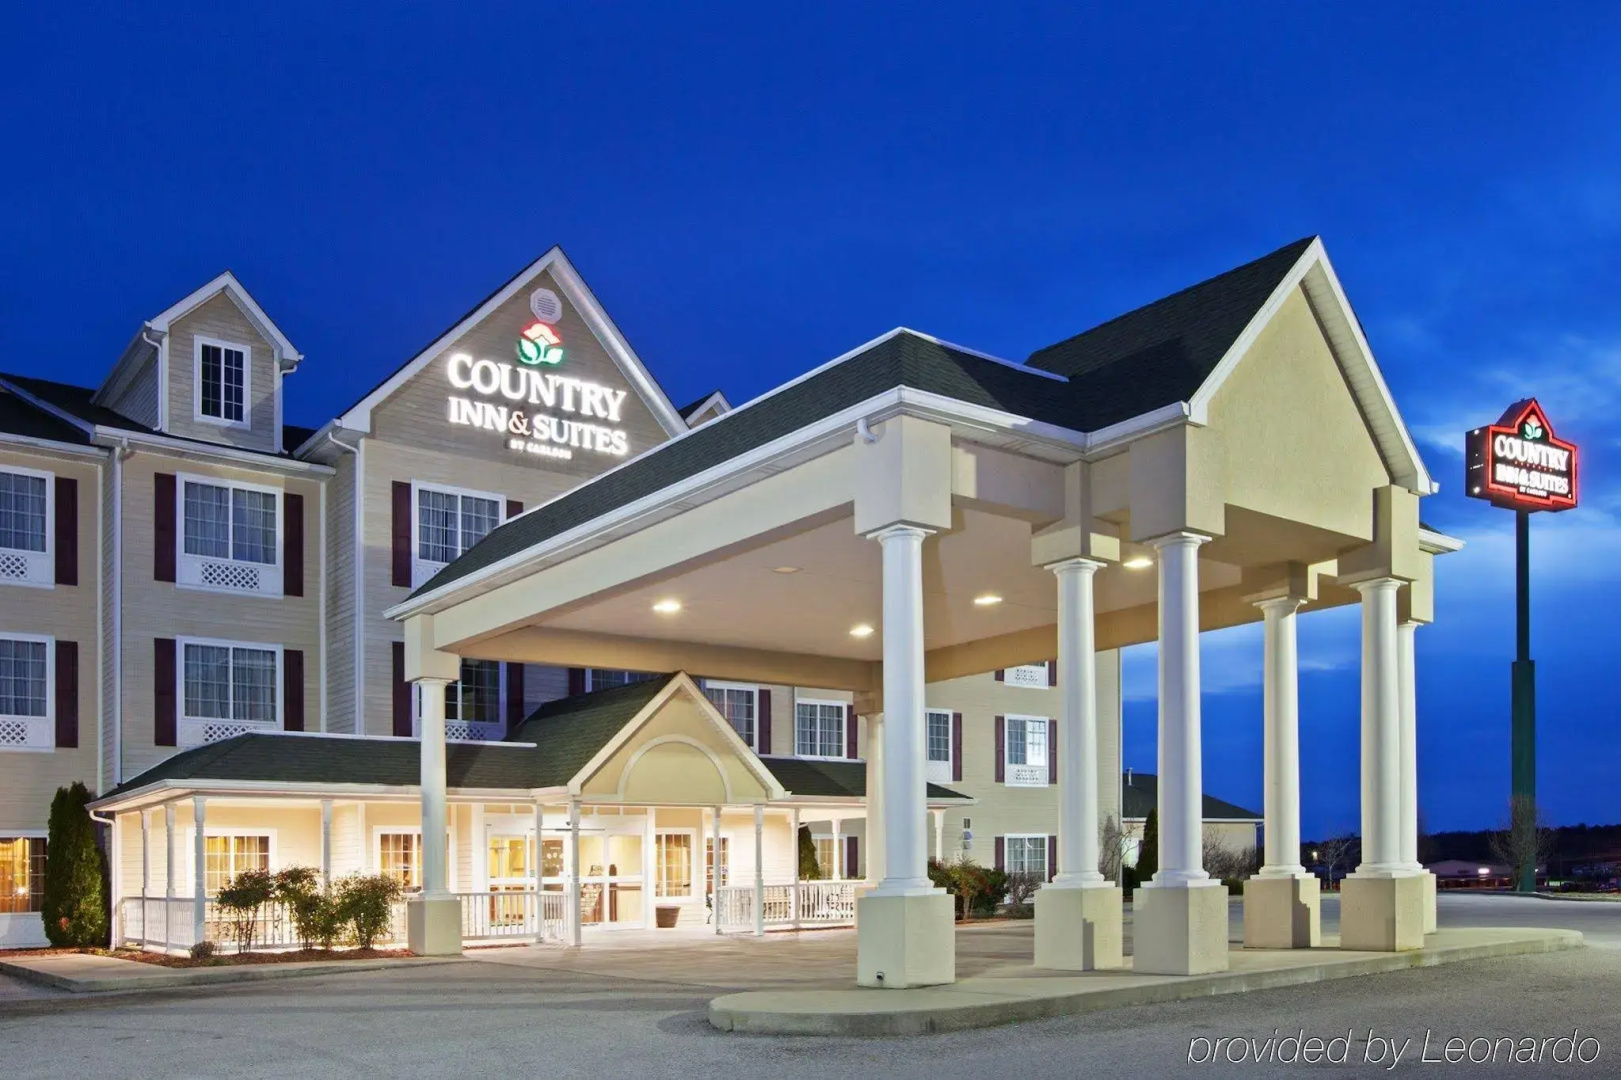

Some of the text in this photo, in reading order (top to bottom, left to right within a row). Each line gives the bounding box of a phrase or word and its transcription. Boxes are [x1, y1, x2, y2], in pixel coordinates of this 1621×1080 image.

[447, 353, 627, 422] COUNTRY
[448, 396, 628, 455] INN & SUITES
[1495, 434, 1569, 471] COUNTRY
[1529, 470, 1569, 494] SUITES
